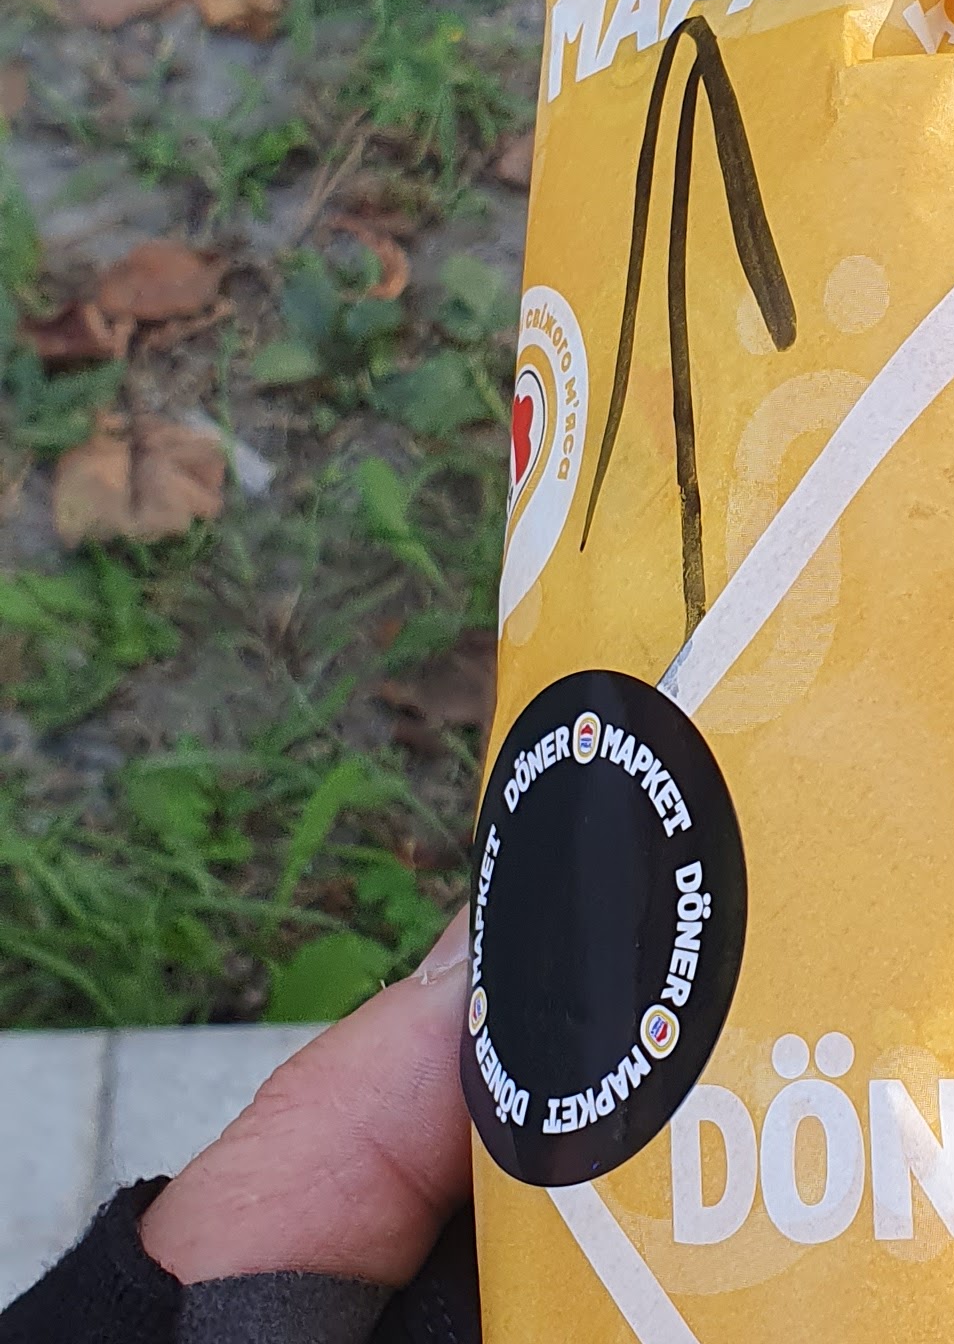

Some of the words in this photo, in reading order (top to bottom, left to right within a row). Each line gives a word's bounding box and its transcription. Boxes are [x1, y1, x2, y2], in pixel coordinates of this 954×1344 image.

[503, 724, 572, 814] DÖNER
[599, 723, 692, 838] МАРКЕТ
[471, 822, 502, 987] МАРКЕТ
[660, 860, 712, 1008] DÖNER
[475, 1025, 531, 1127] DÖNER
[542, 1044, 652, 1135] МАРКЕТ
